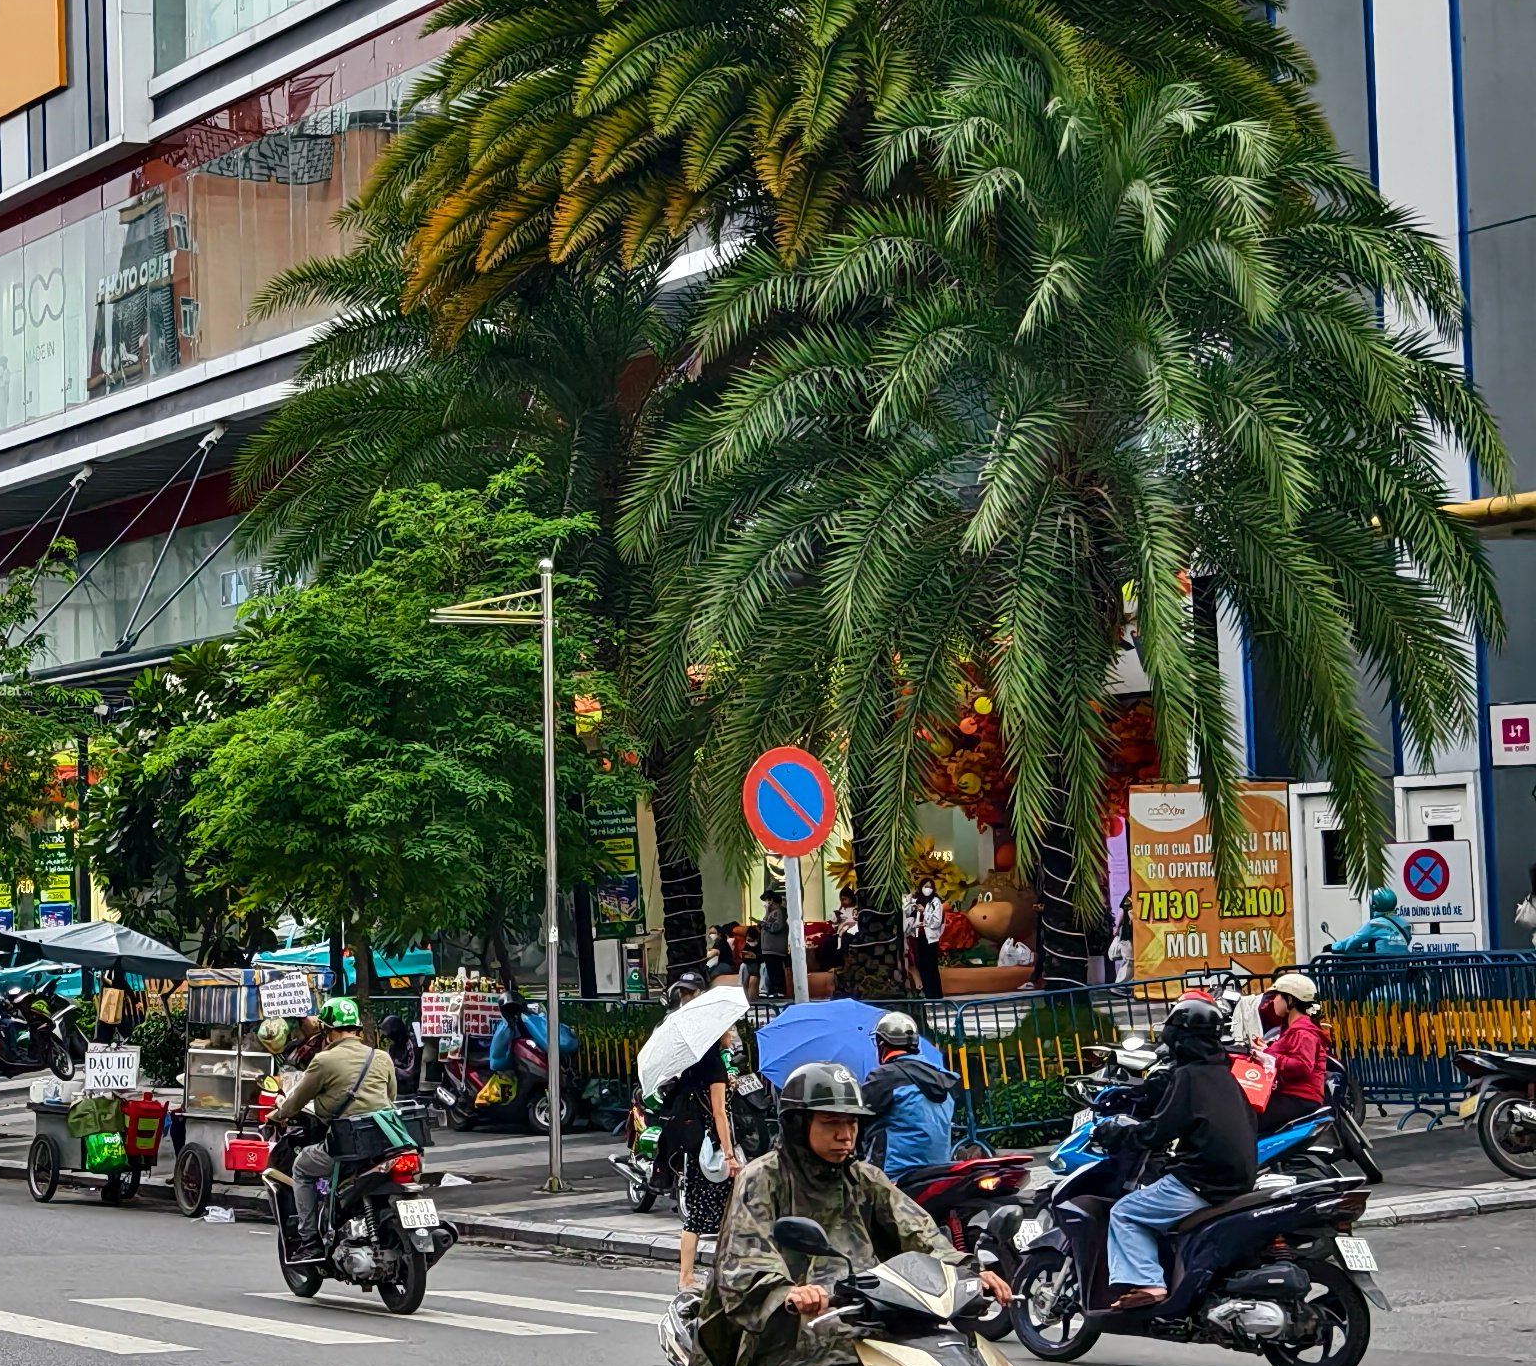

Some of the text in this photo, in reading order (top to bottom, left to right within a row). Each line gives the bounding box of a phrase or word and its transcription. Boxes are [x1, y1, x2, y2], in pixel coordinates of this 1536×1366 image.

[97, 250, 177, 303] PHOTO OBJET
[1138, 890, 1199, 921] 7H30
[1453, 905, 1463, 916] XE
[94, 1072, 129, 1088] NÓNG
